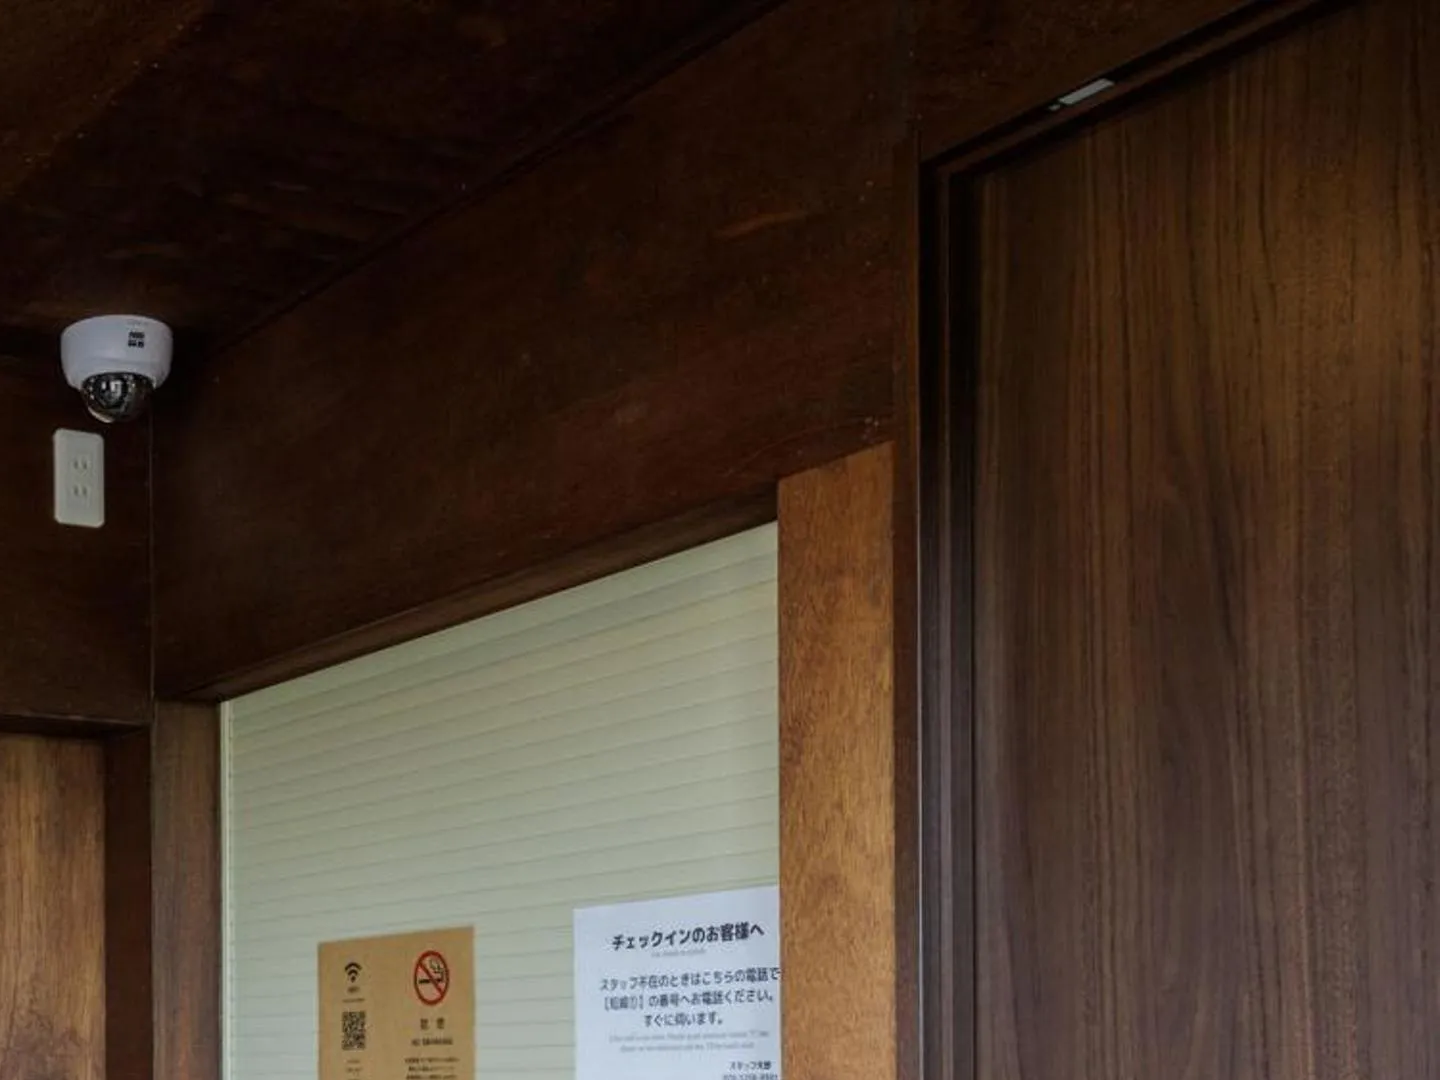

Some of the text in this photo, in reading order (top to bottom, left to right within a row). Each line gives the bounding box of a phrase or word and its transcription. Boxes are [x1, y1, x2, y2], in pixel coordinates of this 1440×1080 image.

[612, 921, 765, 950] チェックインのお客様へ
